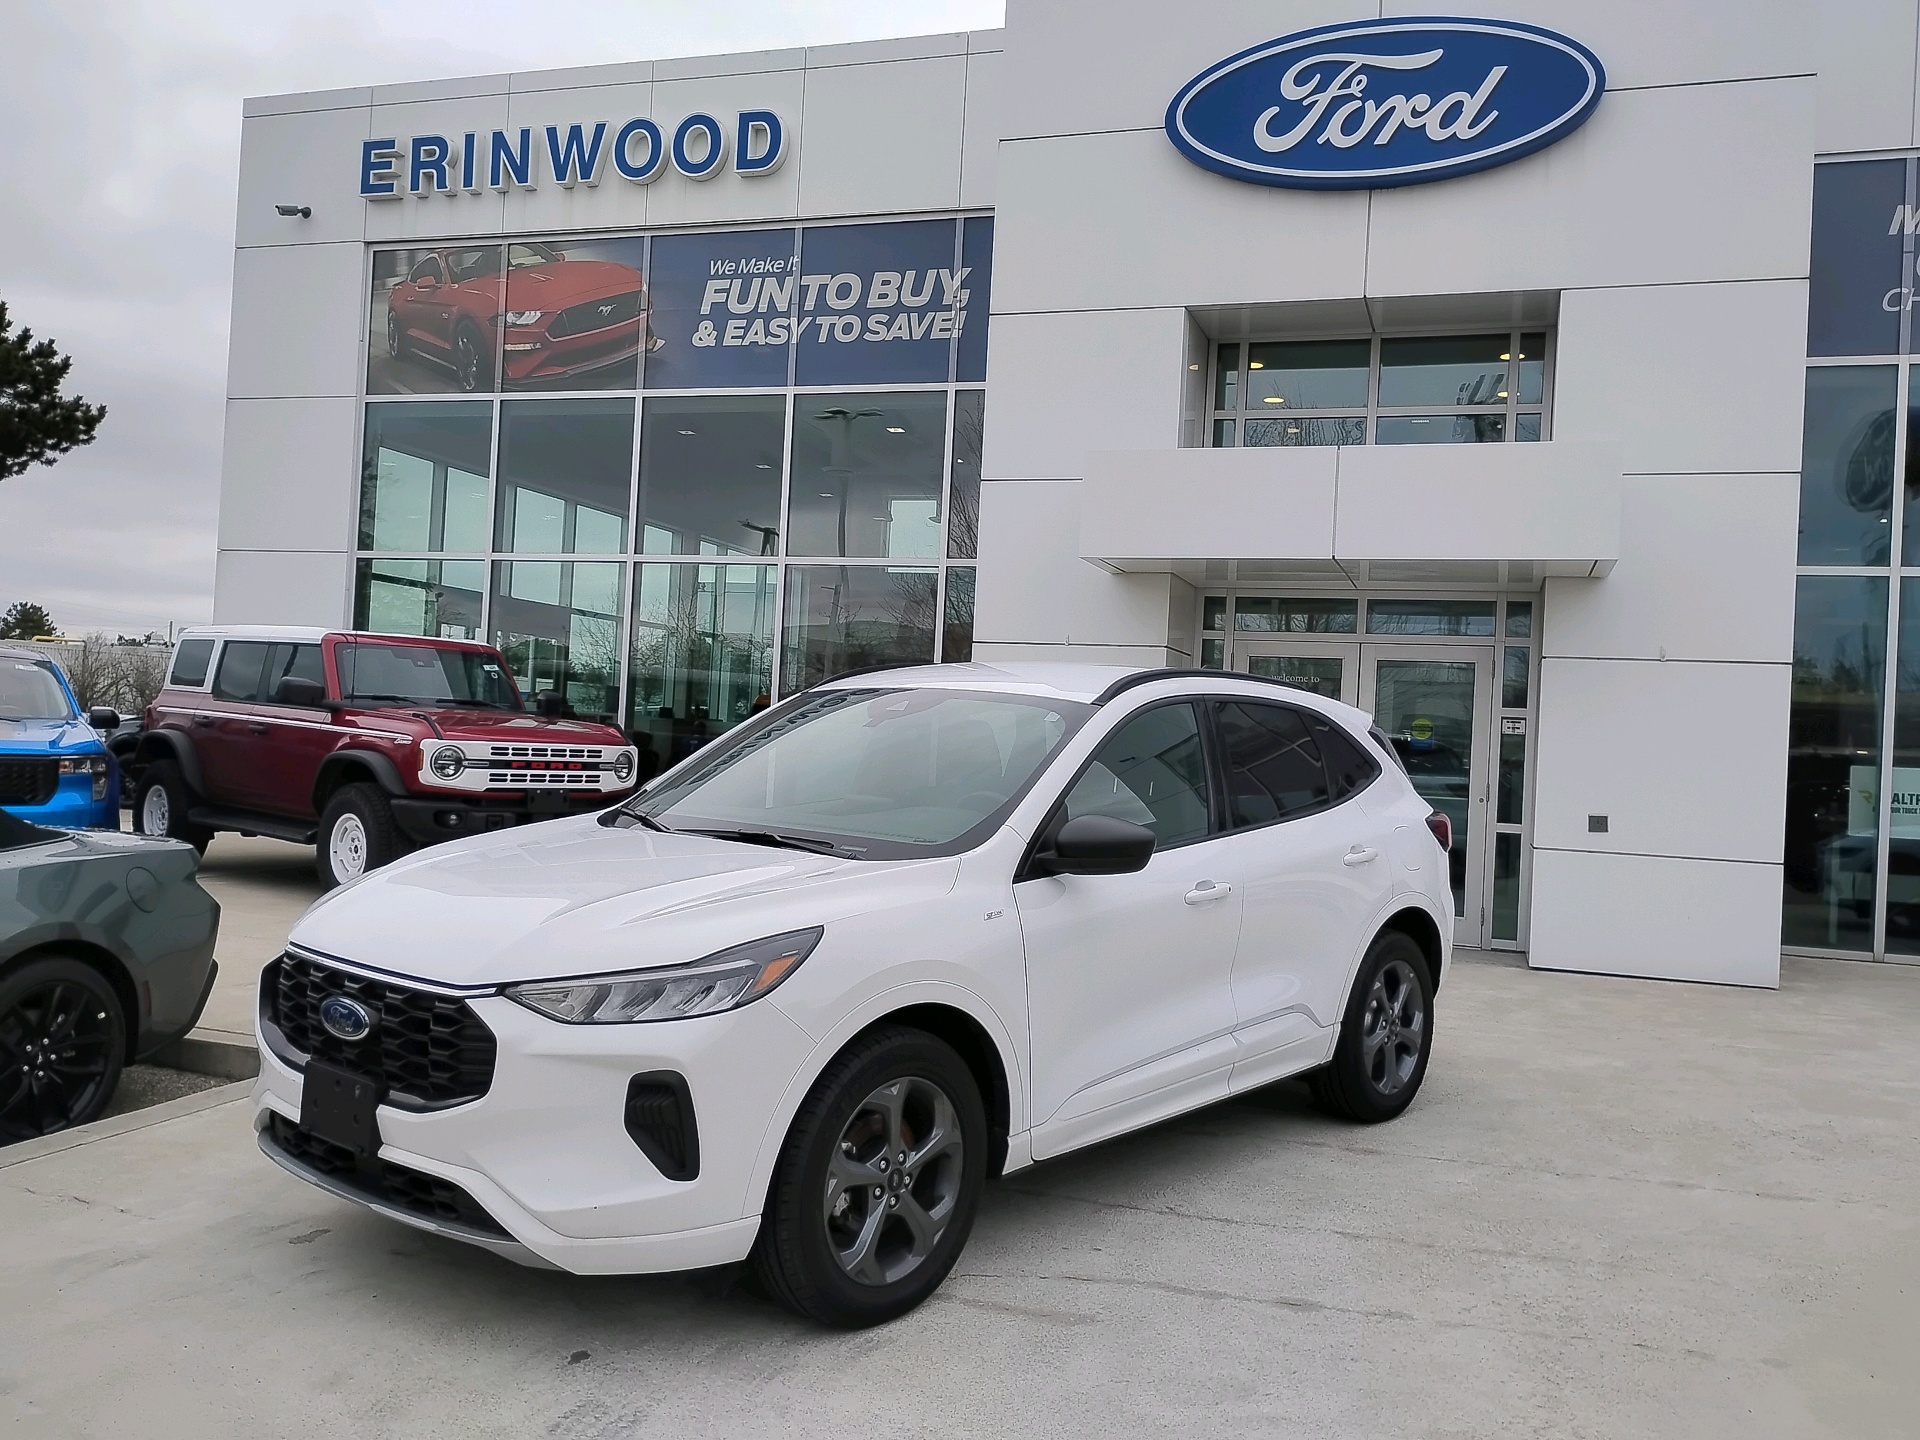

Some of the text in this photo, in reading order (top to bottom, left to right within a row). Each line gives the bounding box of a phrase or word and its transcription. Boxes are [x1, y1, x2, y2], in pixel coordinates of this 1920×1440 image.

[1254, 48, 1508, 152] Ford
[360, 109, 788, 201] ERINWOOD
[709, 255, 799, 276] We Make It
[700, 267, 972, 314] FUN TO BUY,
[692, 310, 967, 347] & EASY TO SAVE!
[1271, 673, 1309, 682] welcome
[511, 761, 582, 769] FORD
[328, 1005, 356, 1032] Ford
